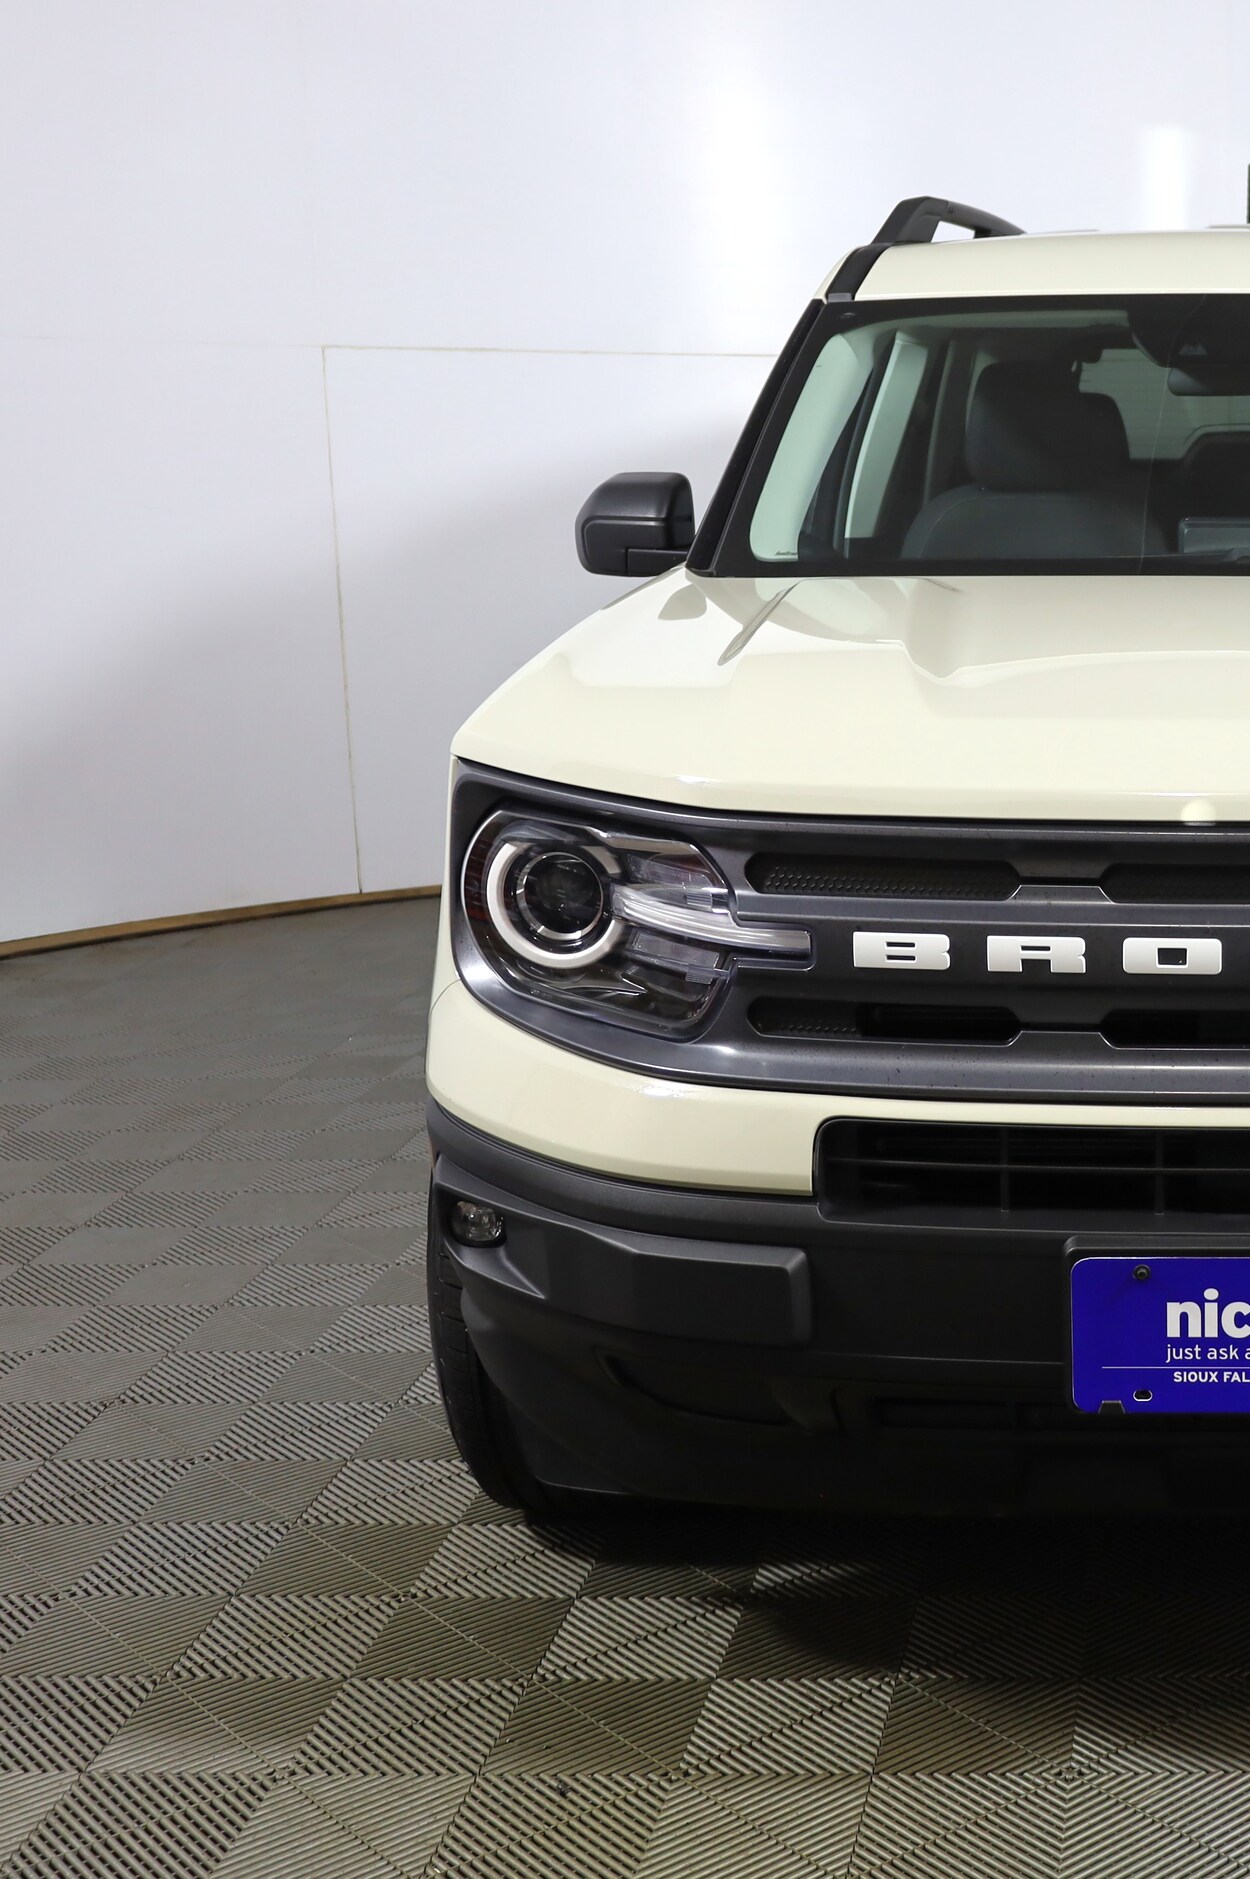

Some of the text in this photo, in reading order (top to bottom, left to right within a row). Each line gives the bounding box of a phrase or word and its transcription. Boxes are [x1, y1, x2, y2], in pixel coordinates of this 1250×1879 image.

[1165, 1344, 1202, 1363] just
[1206, 1344, 1240, 1360] ask
[1173, 1371, 1219, 1383] SIOUX
